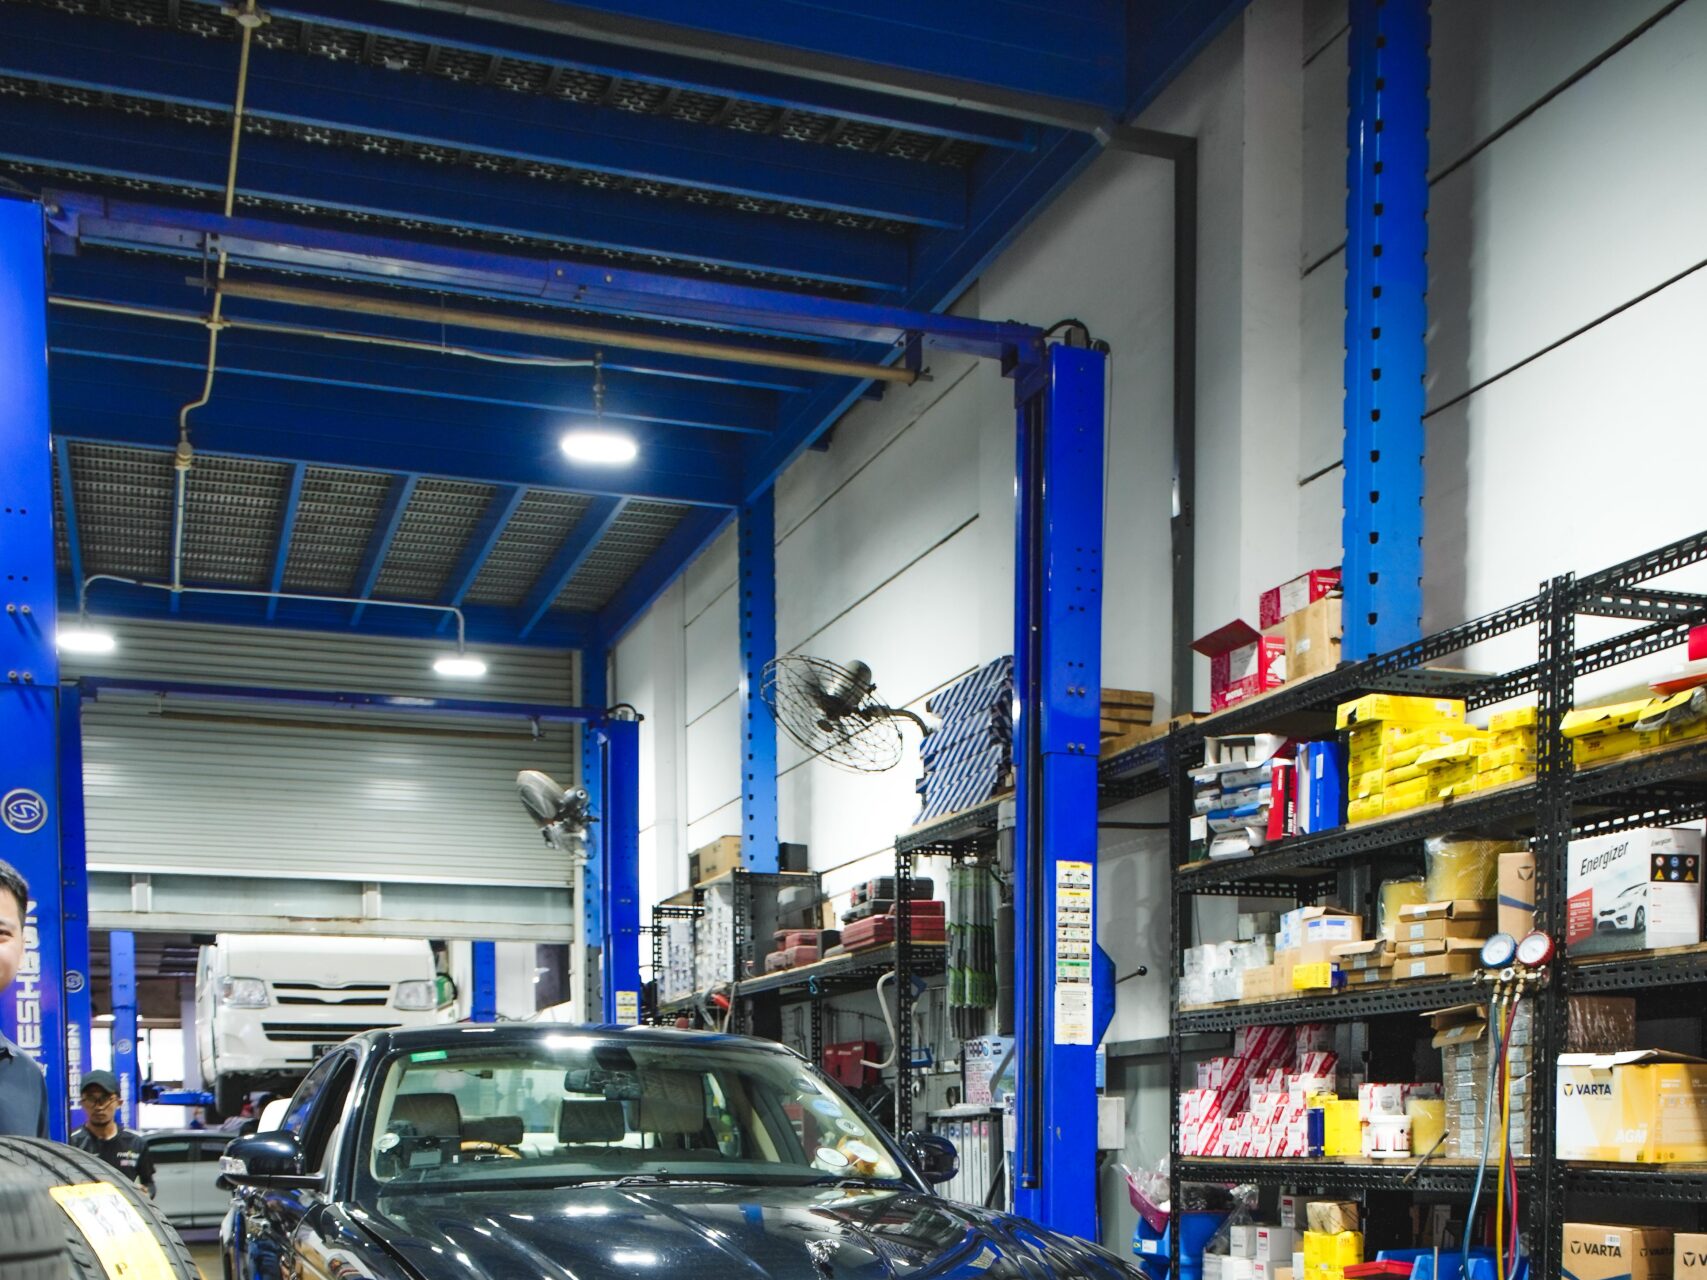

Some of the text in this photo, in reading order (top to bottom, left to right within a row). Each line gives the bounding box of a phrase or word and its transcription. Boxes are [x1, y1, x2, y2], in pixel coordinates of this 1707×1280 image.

[1580, 841, 1629, 876] Energizer
[1576, 1084, 1612, 1095] VARTA
[1583, 1242, 1622, 1258] VARTA
